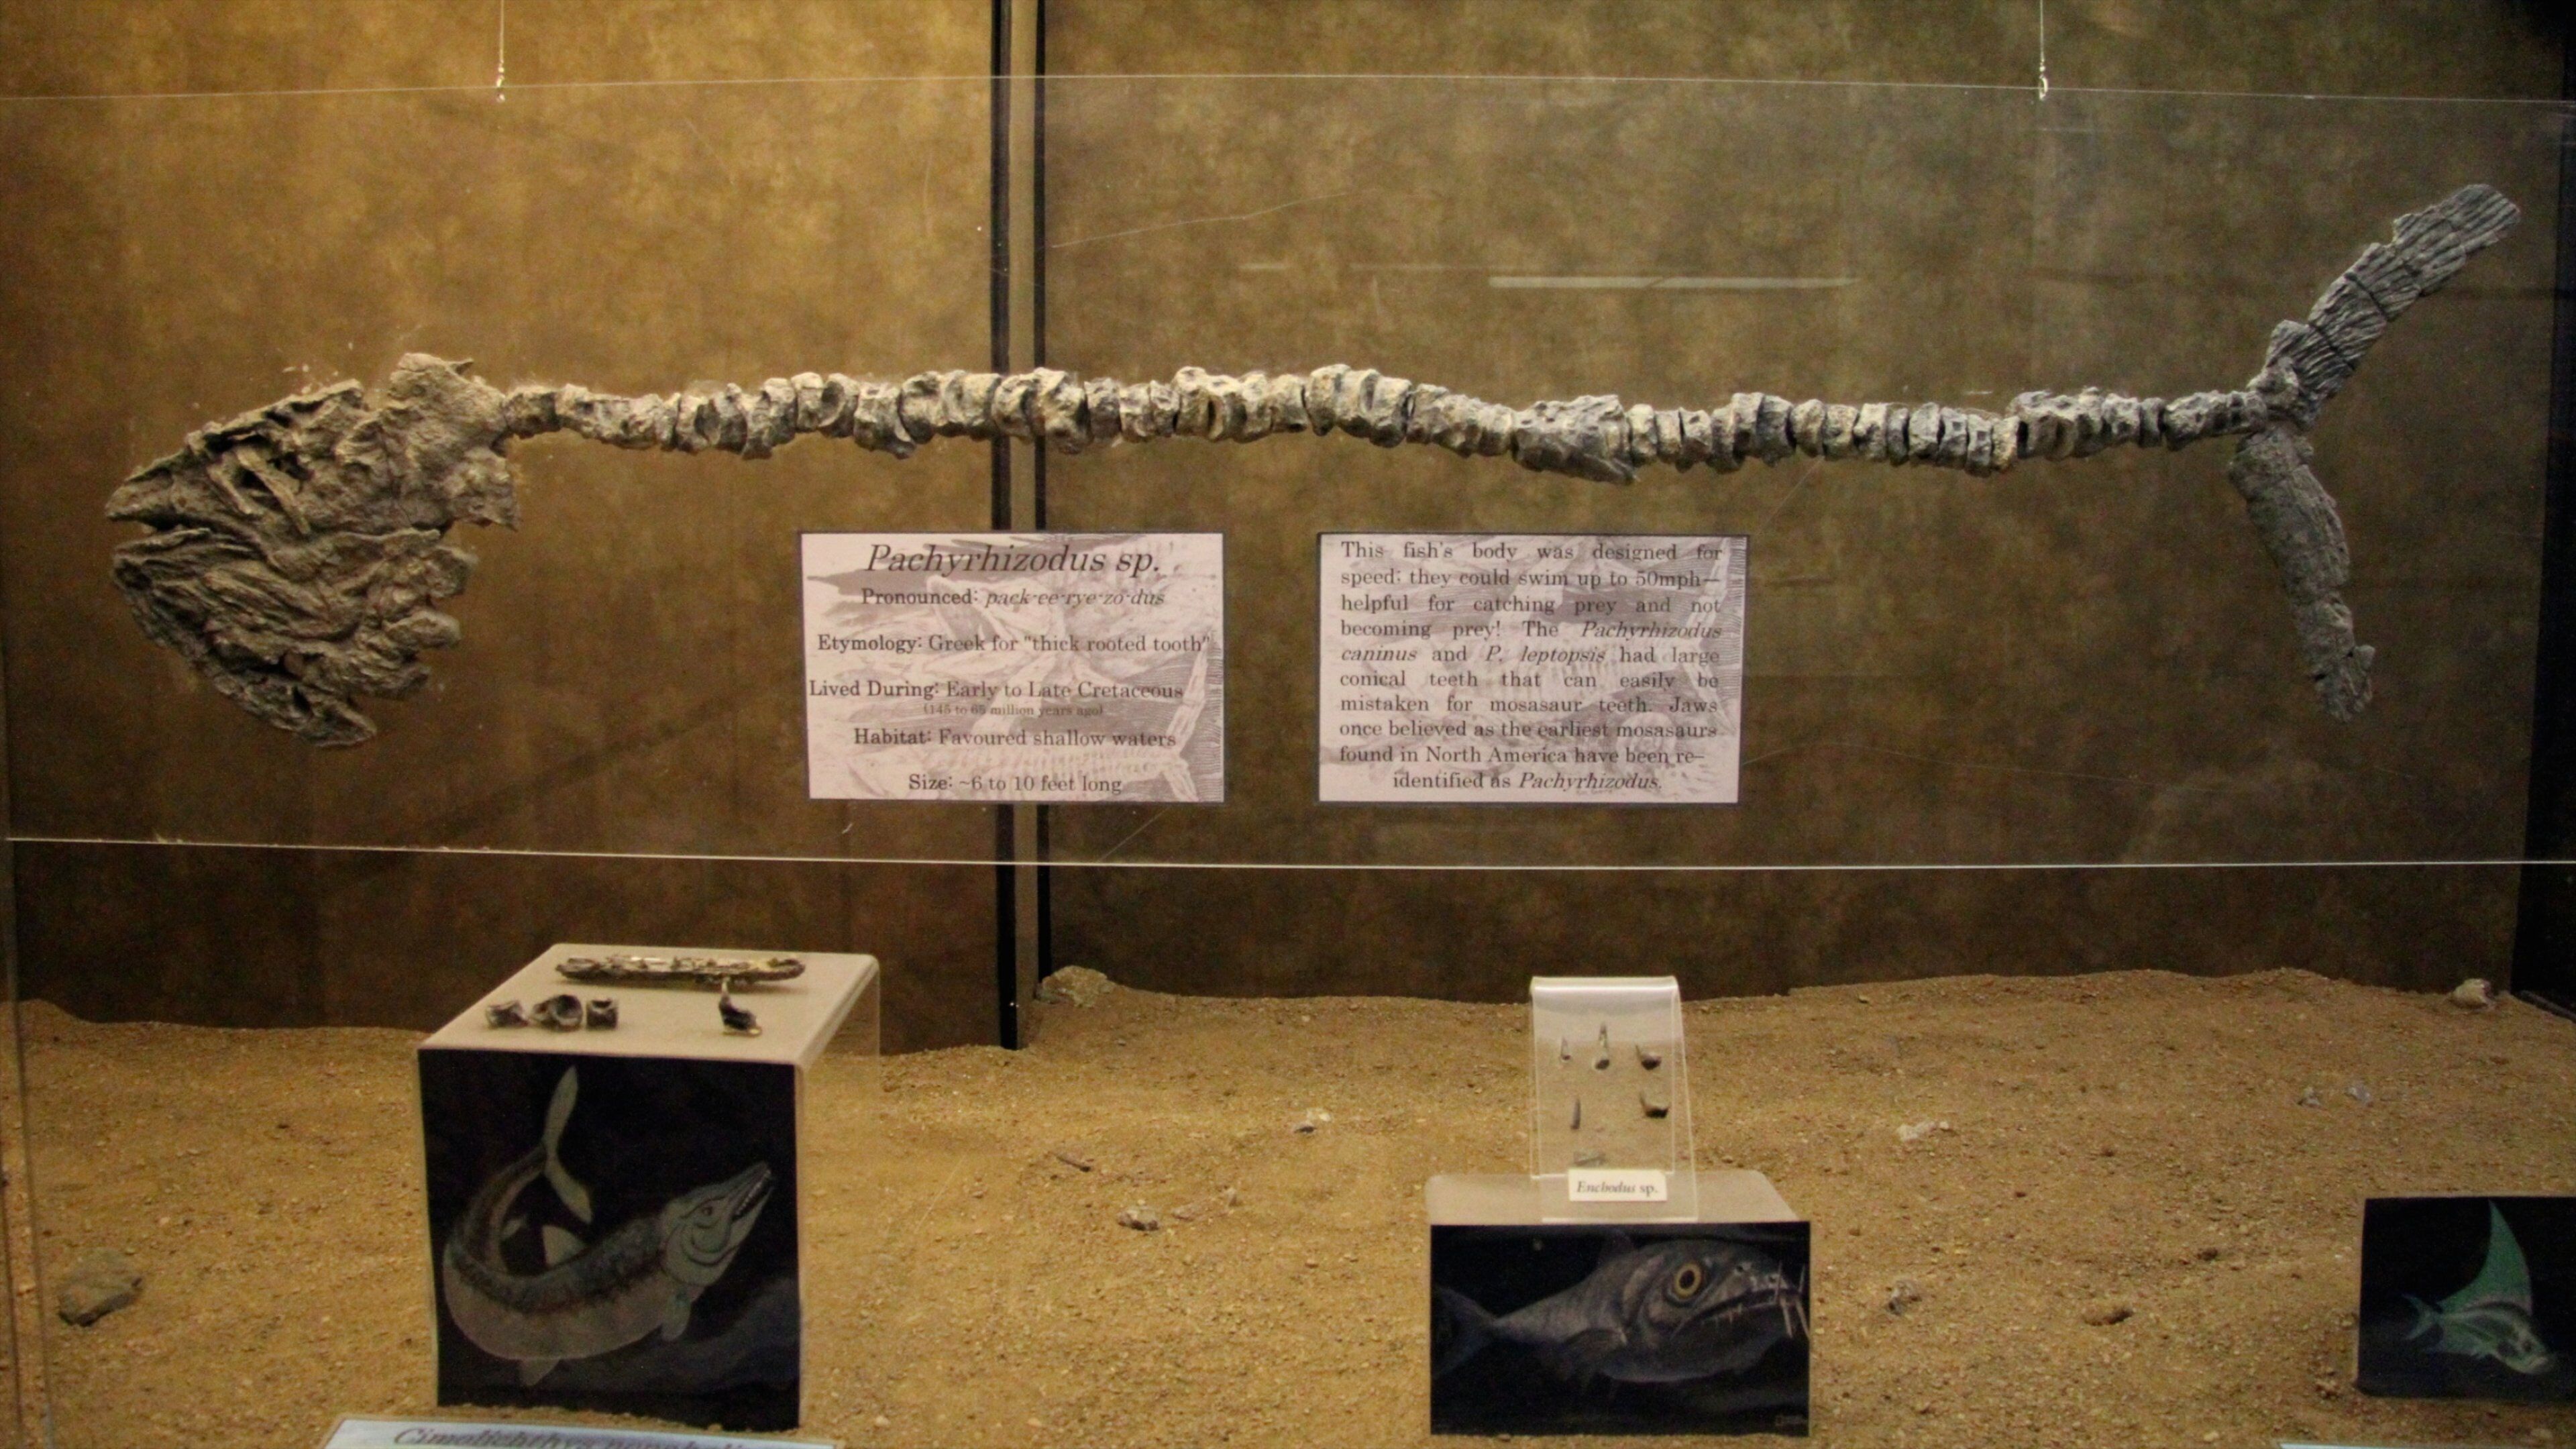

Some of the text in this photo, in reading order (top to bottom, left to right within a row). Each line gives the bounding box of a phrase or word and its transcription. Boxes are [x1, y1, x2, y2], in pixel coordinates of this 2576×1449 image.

[865, 543, 1159, 578] Pachyrhizodus sp.
[1342, 541, 1723, 563] This fish's body was designed for
[1341, 568, 1401, 588] speed;
[1409, 568, 1452, 588] they
[1459, 569, 1509, 586] could
[1518, 569, 1568, 586] swim
[1577, 575, 1601, 590] up
[1610, 572, 1627, 586] to
[862, 588, 1165, 608] Pronounced: pack-ee-rye-zo-dus
[1341, 594, 1721, 616] helpful for catching prey and not
[1341, 620, 1723, 641] becoming prey! The Pachyrhizodus
[818, 634, 1210, 653] Etymology: Greek for "thick rooted tooth"
[1341, 645, 1719, 665] caninus and P. leptopsis had large
[809, 680, 1184, 700] Lived During: Early to Late Cretaceous
[1340, 670, 1718, 691] conical teeth that can easily be
[955, 704, 967, 715] to
[990, 704, 1034, 716] million
[1038, 706, 1072, 718] years
[1076, 705, 1104, 718] ago)
[1340, 694, 1717, 713] mistaken for mosasaur teeth. Jaws
[854, 728, 1176, 746] Habitat: Favoured shallow waters
[1340, 720, 1717, 738] once believed as the earliest mosasaurs
[1340, 745, 1393, 762] found
[1401, 746, 1417, 762] in
[1426, 746, 1481, 763] North
[1488, 747, 1566, 763] America
[1574, 747, 1619, 763] have
[1626, 747, 1668, 763] been
[908, 773, 1122, 794] Size: ~6 to 10 feet long
[1393, 771, 1662, 792] identified as Pachyrhizodus.
